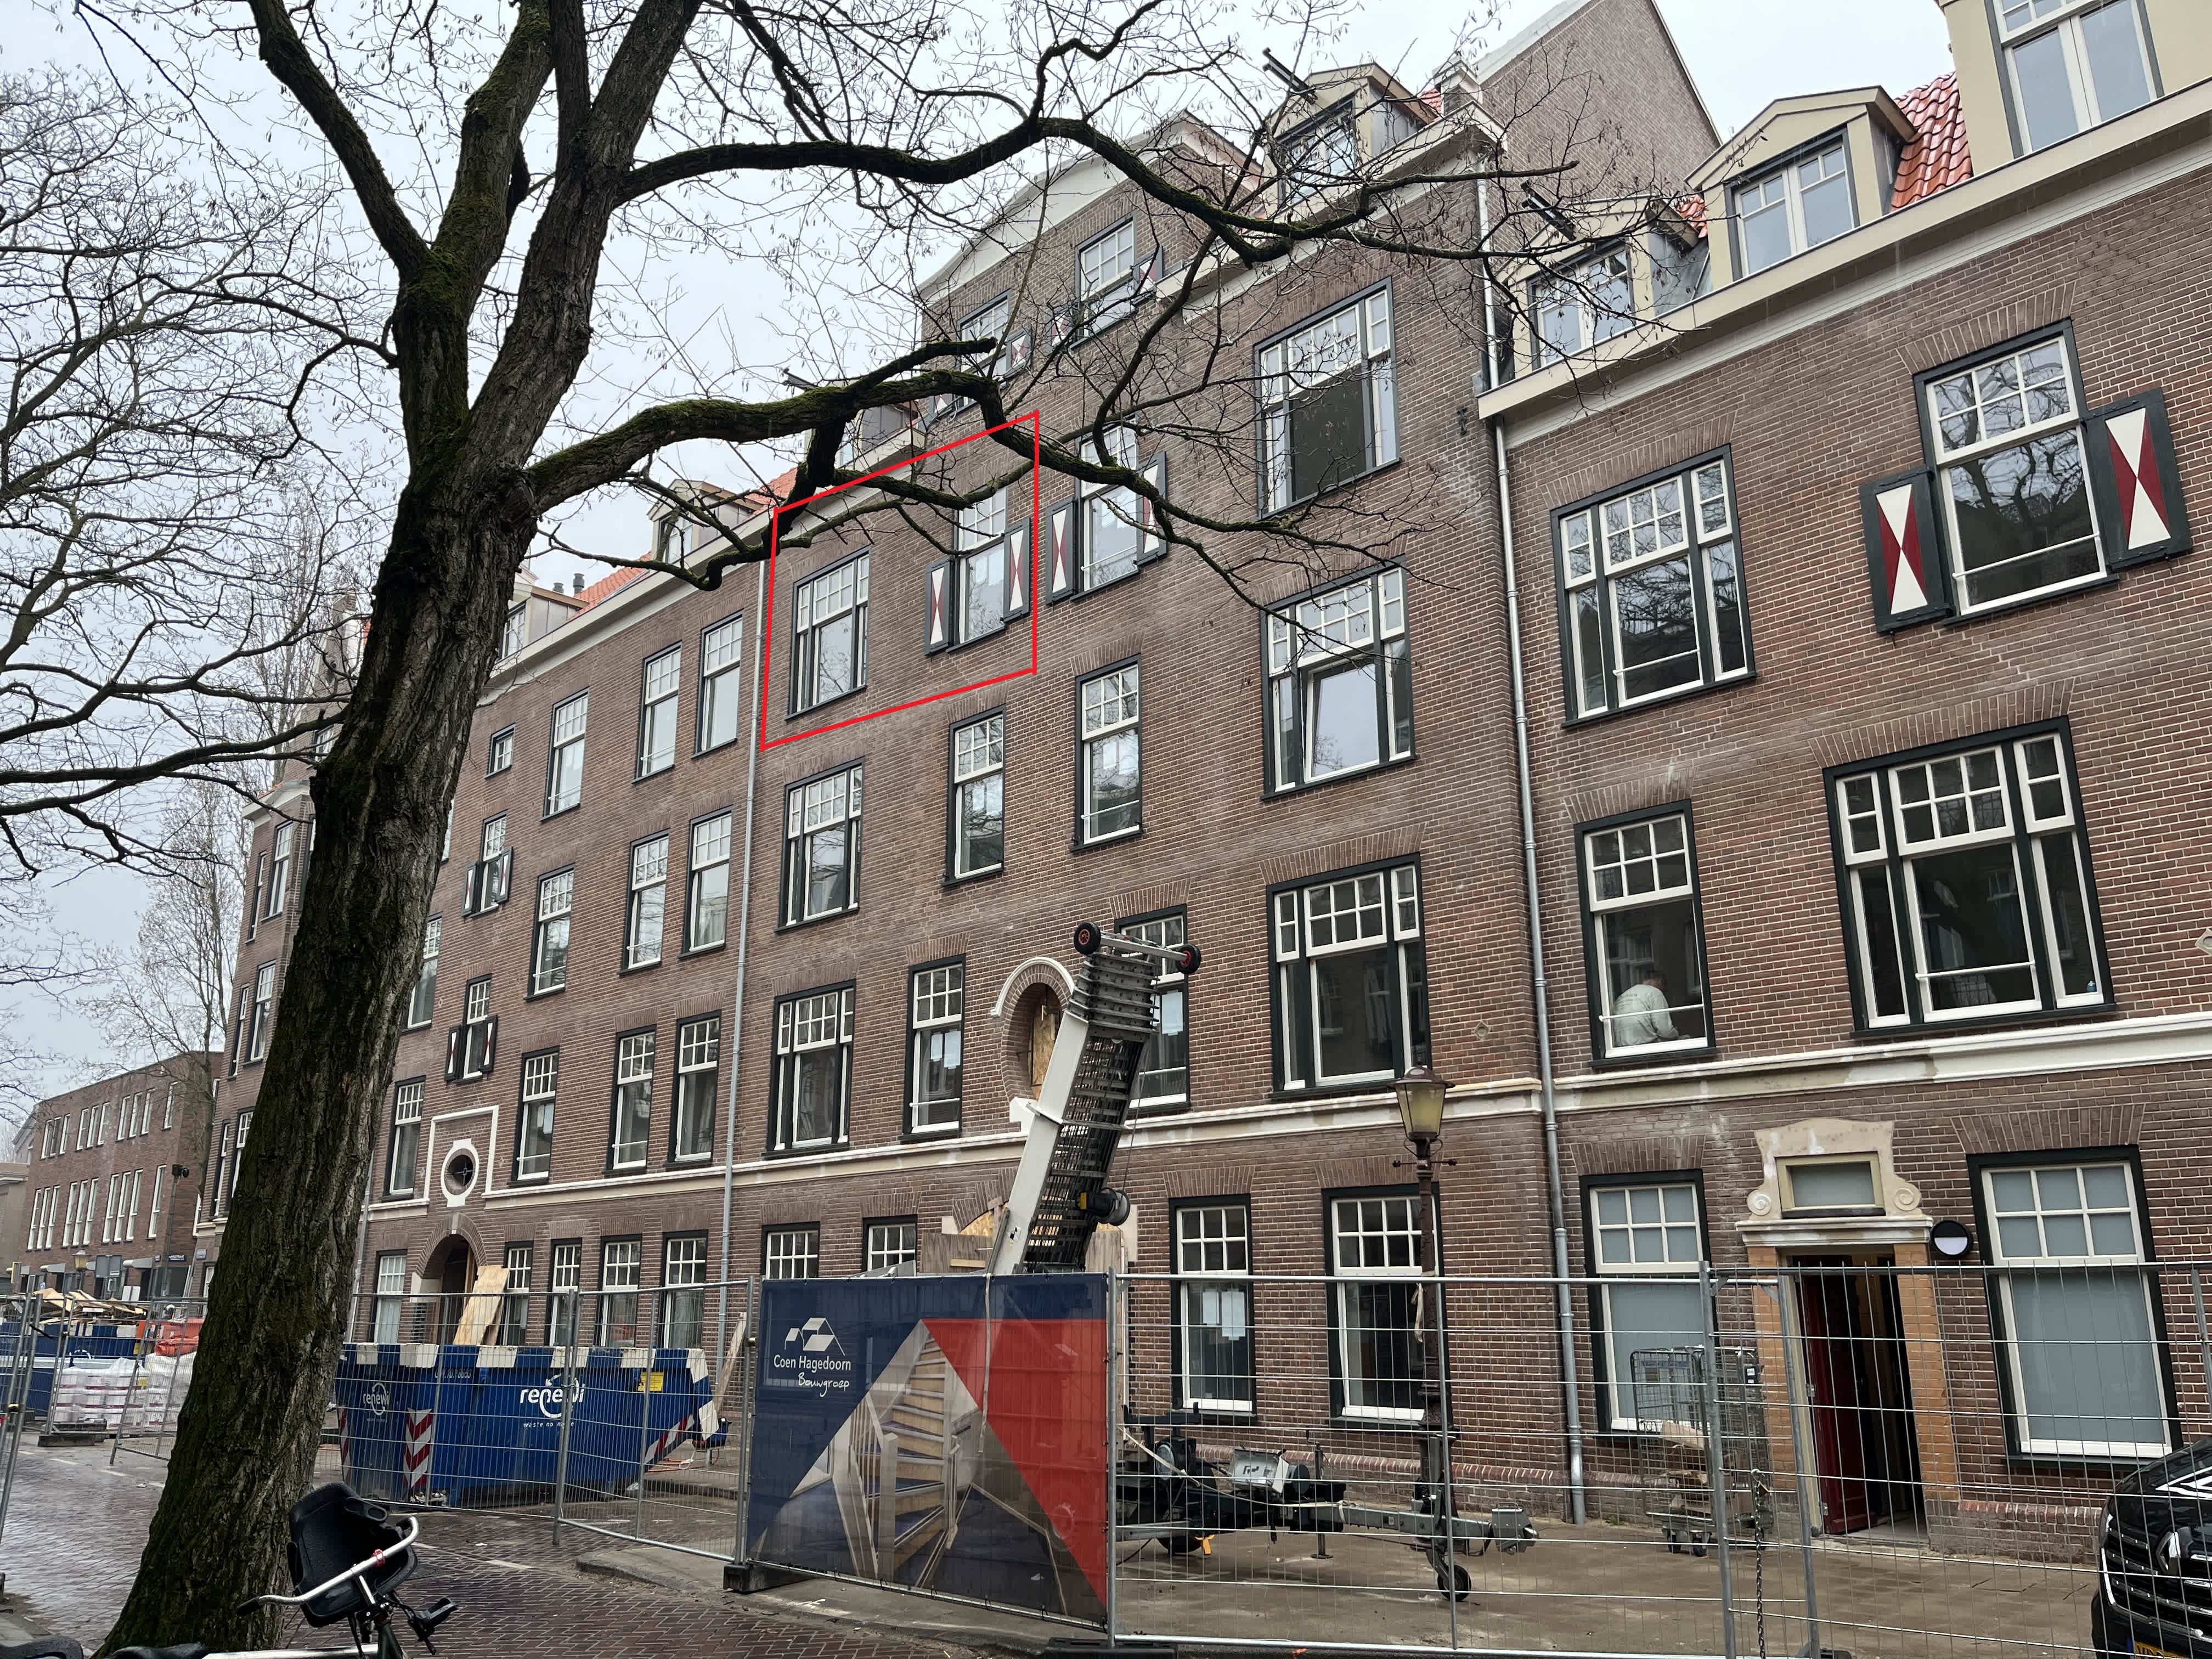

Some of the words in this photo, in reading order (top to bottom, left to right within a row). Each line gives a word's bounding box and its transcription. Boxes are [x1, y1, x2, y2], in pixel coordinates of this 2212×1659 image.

[774, 1354, 795, 1368] Coen
[799, 1356, 851, 1373] Hagedoorn
[798, 1372, 850, 1397] Bouwgroep
